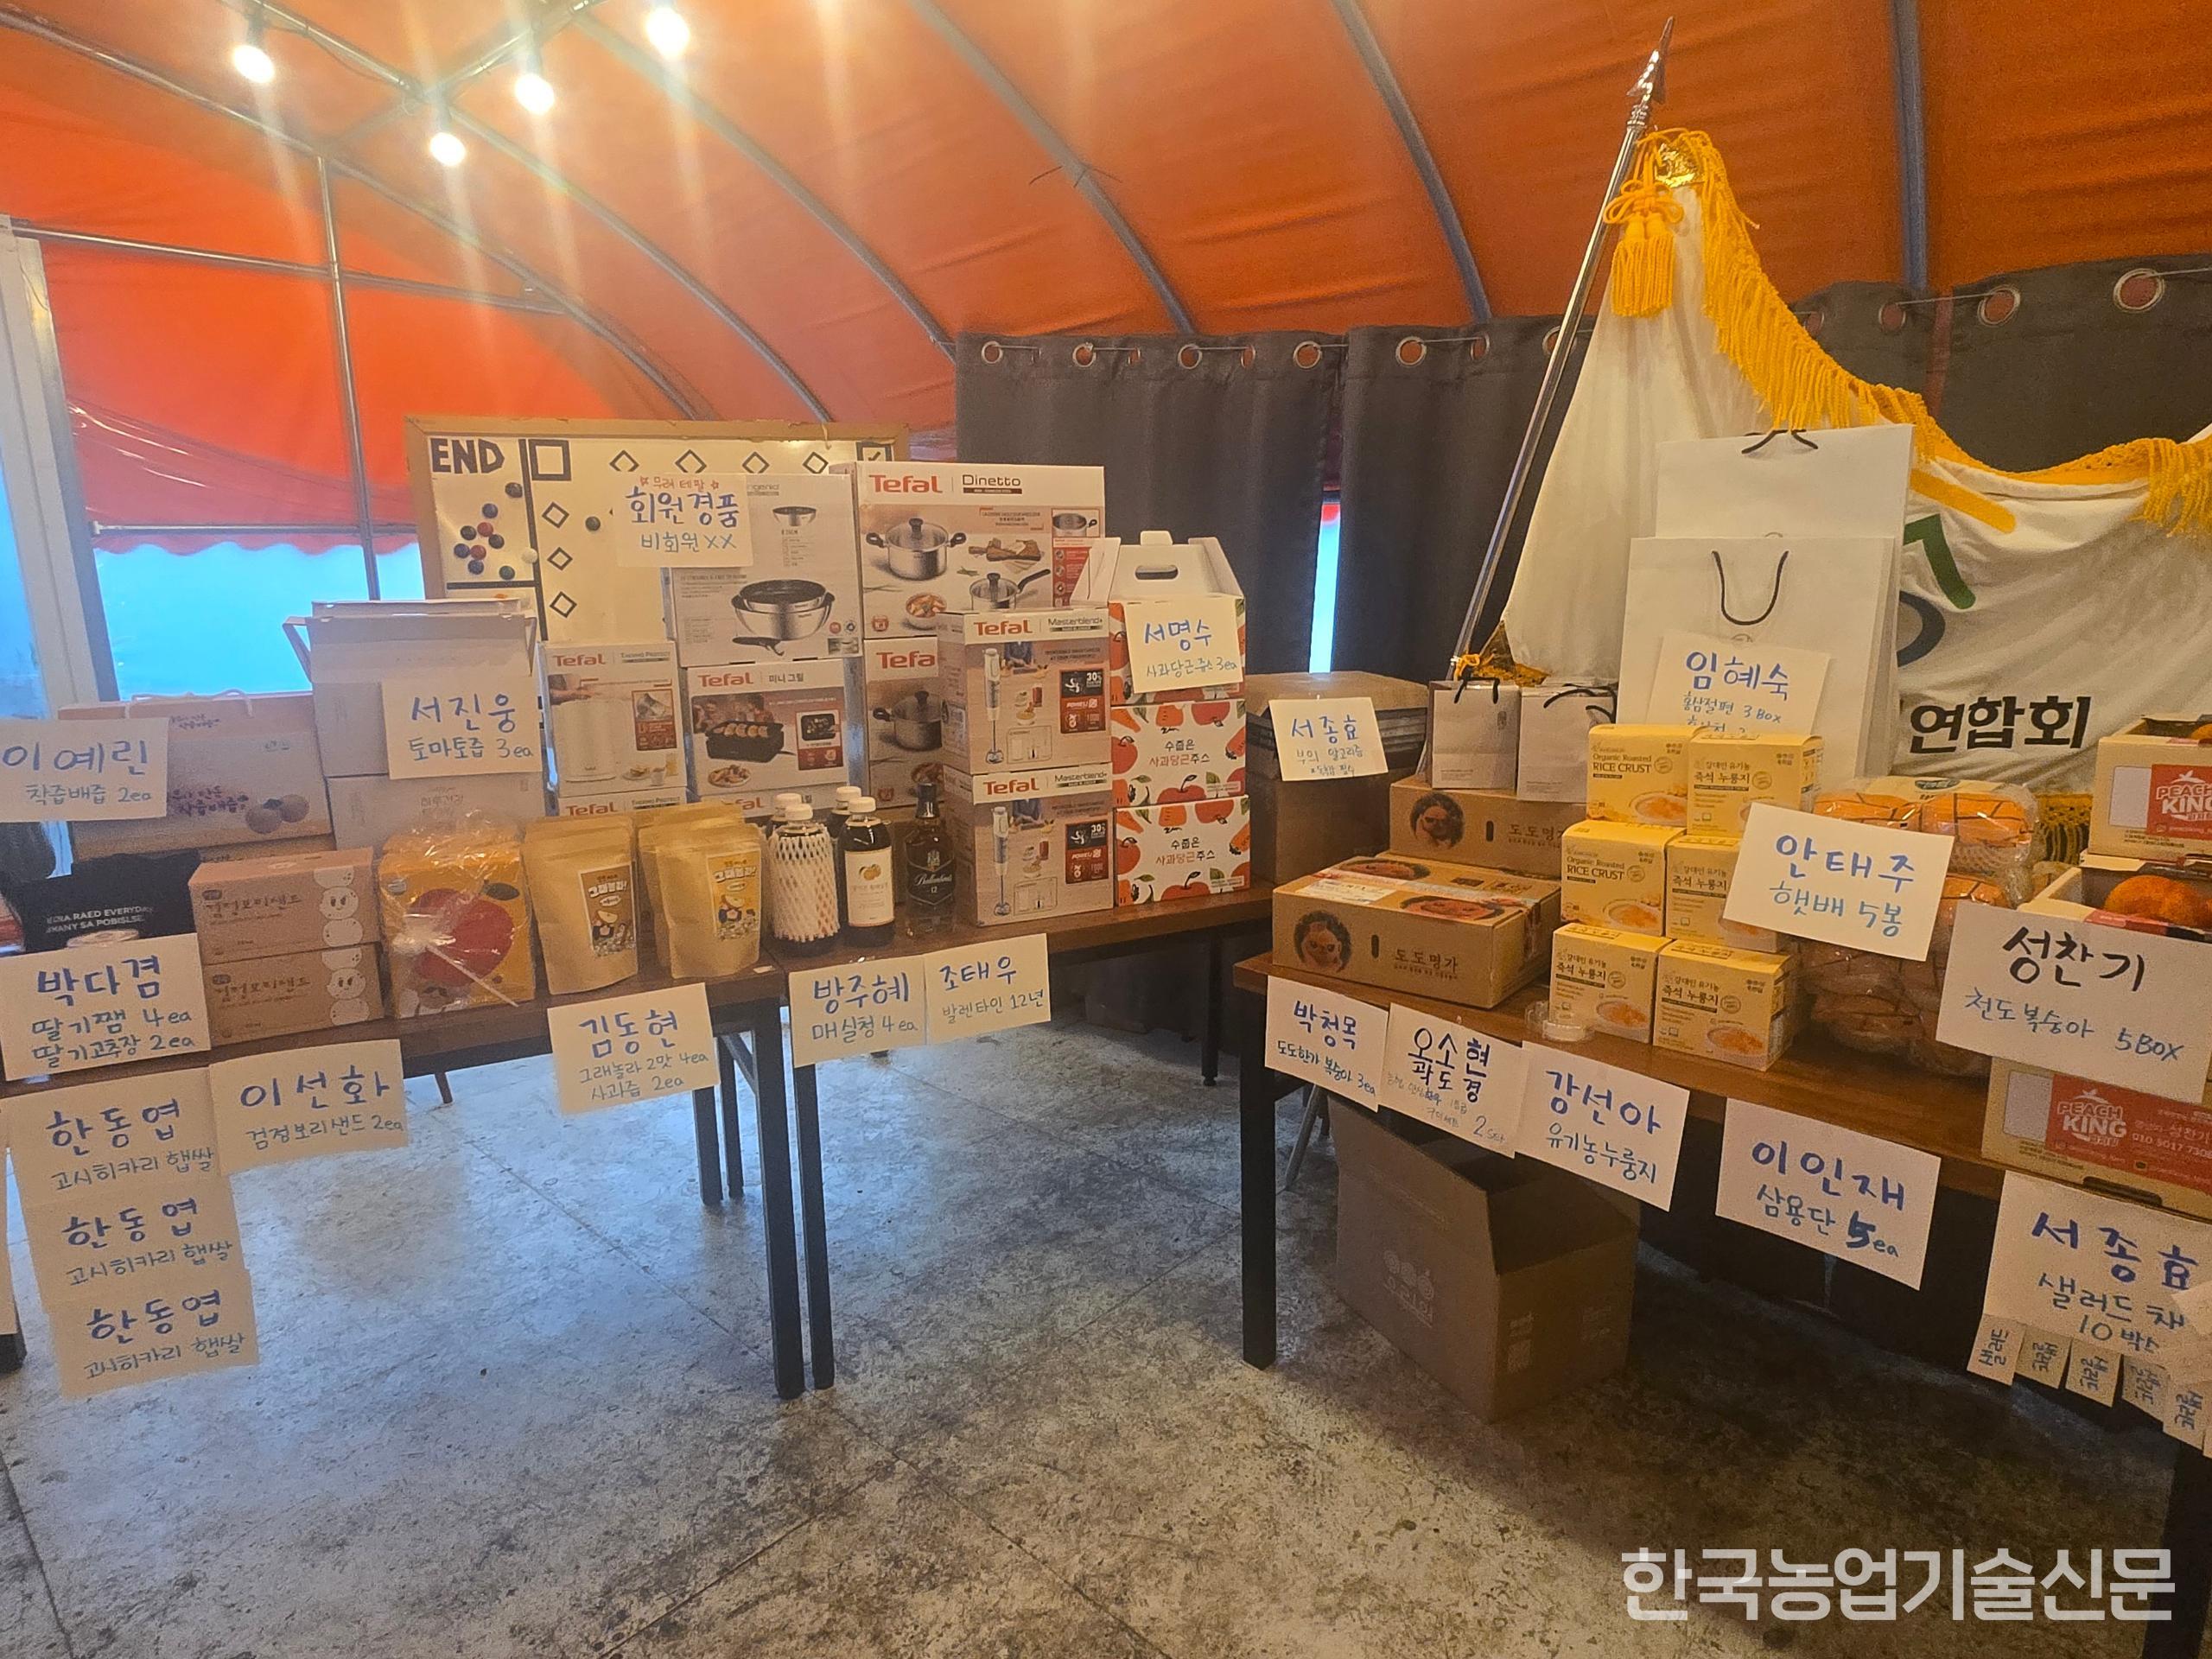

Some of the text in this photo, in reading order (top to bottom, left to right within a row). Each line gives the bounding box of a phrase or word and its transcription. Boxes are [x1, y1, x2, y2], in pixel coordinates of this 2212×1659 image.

[430, 438, 505, 474] END
[678, 479, 704, 493] 테팔
[868, 474, 1021, 493] Tefal Dinetto
[641, 531, 700, 553] 비회원
[974, 620, 1033, 636] Tefal
[1144, 619, 1211, 652] 서명수
[553, 653, 606, 667] Tefal
[876, 650, 936, 670] Tefa
[1216, 657, 1237, 671] 3ea
[697, 671, 754, 688] Tefal
[1686, 652, 1789, 701] 임혜숙
[410, 693, 516, 733] 서진웅
[1291, 714, 1359, 744] 서종효
[1910, 696, 2091, 754] 연합회
[3, 740, 148, 775] 이예린
[409, 737, 534, 761] 토마토즙 3ea
[1148, 753, 1211, 767] 사과당근주스
[1592, 761, 1652, 773] RICE CRUST
[1694, 772, 1750, 785] 즉석 누룽지
[26, 785, 106, 805] 착즙배즙
[118, 785, 151, 802] 2ea
[983, 778, 1039, 795] Tefal
[565, 802, 618, 817] Tefal
[1155, 850, 1216, 866] 사과당근주스
[1567, 864, 1625, 880] RICE CRUST
[1776, 835, 1914, 893] 안태주
[1696, 878, 1727, 891] 누룽지
[1770, 880, 1903, 938] 햇배 5봉
[940, 956, 1016, 991] 조태우
[1395, 949, 1458, 975] 도도명가
[1578, 967, 1606, 981] 누룽지
[2002, 926, 2145, 991] 성찬기
[37, 955, 161, 1006] 박다겸
[813, 972, 909, 1014] 방주혜
[943, 988, 1045, 1025] 발렌타인 12년
[1688, 990, 1719, 1006] 누룽지
[31, 1009, 126, 1041] 딸기쨈
[578, 1009, 678, 1058] 김동현
[812, 1015, 874, 1044] 매실청
[32, 1034, 195, 1069] 딸기고추장 2ea
[1408, 1027, 1491, 1077] 오소현
[580, 1052, 709, 1084] 그래놀라 2맛 4ea
[1411, 1061, 1482, 1103] 곽도경
[240, 1065, 391, 1109] 이선화
[592, 1076, 685, 1101] 사과즙 2ea
[1358, 1073, 1376, 1097] 3ea
[1546, 1070, 1662, 1135] 강선아
[2057, 1101, 2123, 1120] PEACH
[46, 1098, 181, 1156] 한동엽
[245, 1114, 404, 1150] 검정보리샌드 2ea
[2063, 1115, 2126, 1138] KING
[50, 1147, 215, 1191] 고시히카리 햅쌀
[1751, 1141, 1904, 1211] 이인재
[61, 1197, 198, 1249] 한동엽
[1756, 1184, 1899, 1258] 삼용단 5ea
[66, 1240, 232, 1287] 고시히카리 햅쌀
[2031, 1211, 2200, 1290] 서종효
[2037, 1273, 2133, 1323] 샐러드
[86, 1288, 221, 1344] 한동엽
[190, 1332, 245, 1357] 햅쌀
[1978, 1329, 2009, 1366] 샐러드
